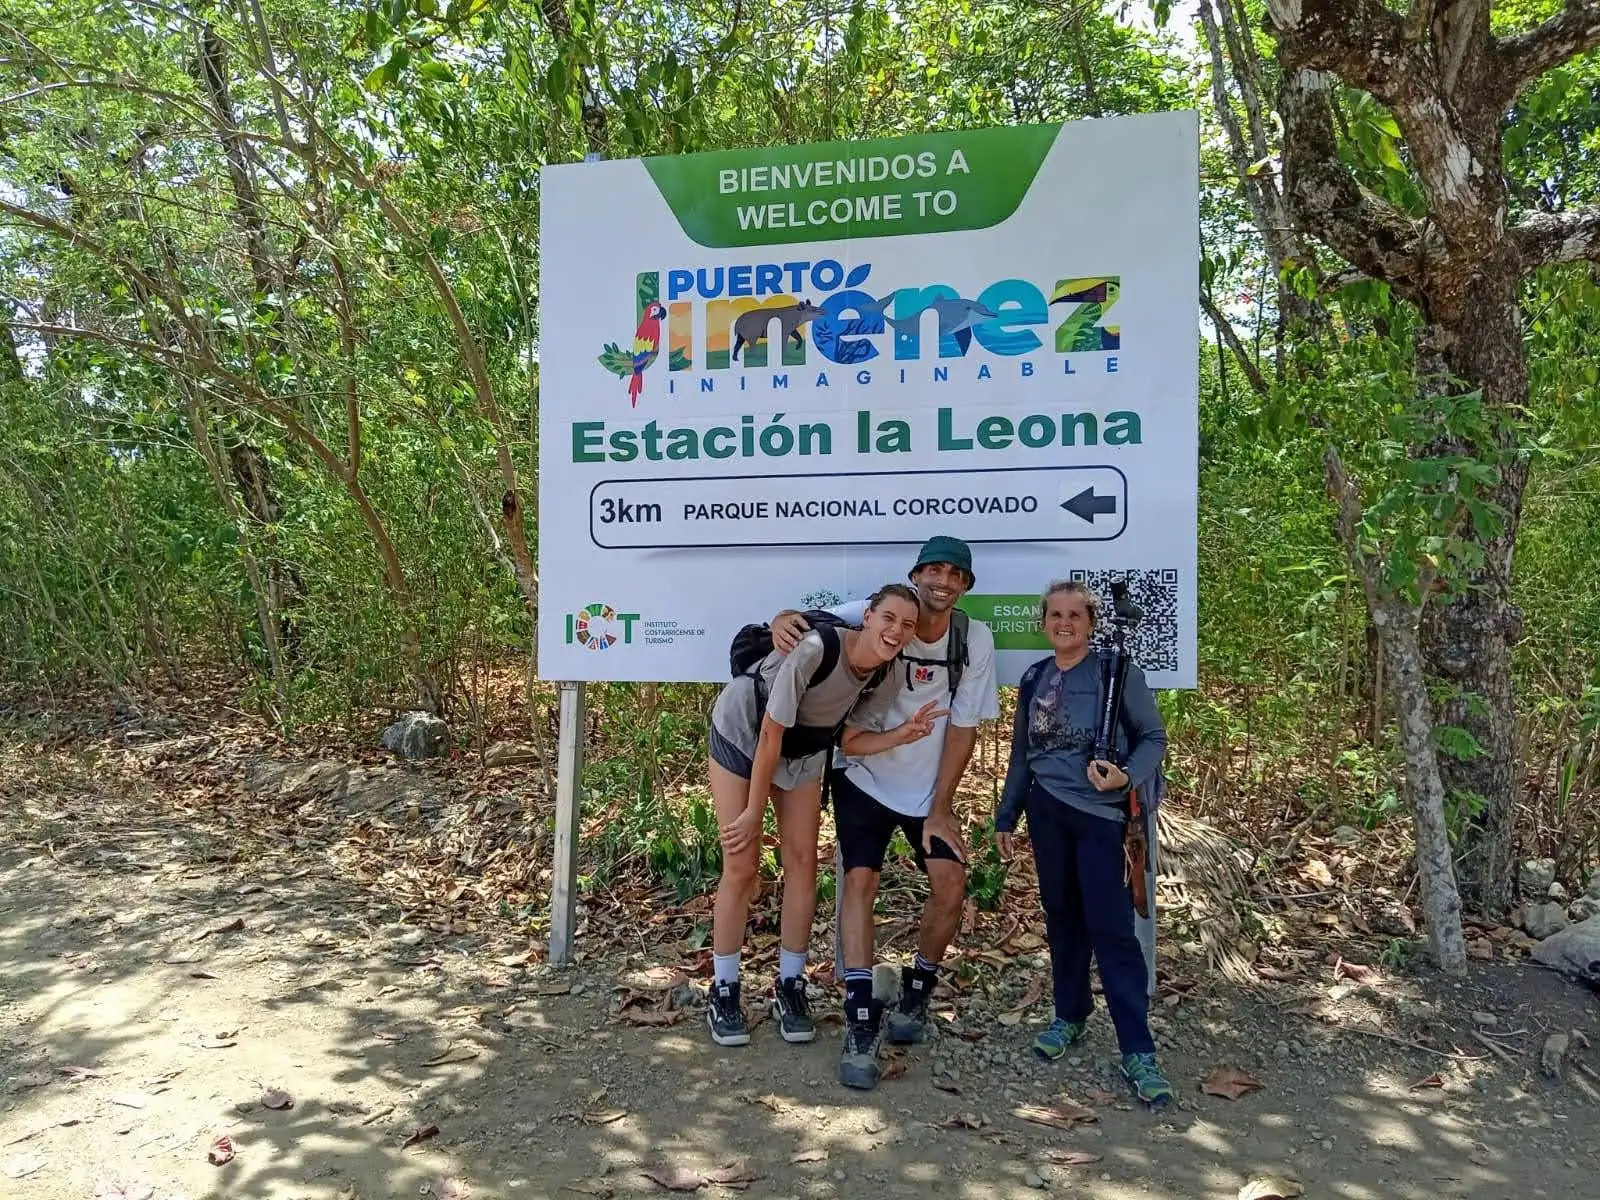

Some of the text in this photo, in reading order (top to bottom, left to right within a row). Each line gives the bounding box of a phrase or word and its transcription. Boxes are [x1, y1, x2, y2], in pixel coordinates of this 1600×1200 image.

[719, 149, 970, 195] BIENVENIDOS A
[736, 190, 958, 231] WELCOME TO
[668, 259, 844, 301] PUERTO
[669, 357, 1119, 394] INIMAGINABLE
[571, 407, 1143, 464] Estación la Leona
[599, 495, 1039, 525] 3km PARQUE NACIONAL CORCOVADO
[565, 603, 641, 651] ICT
